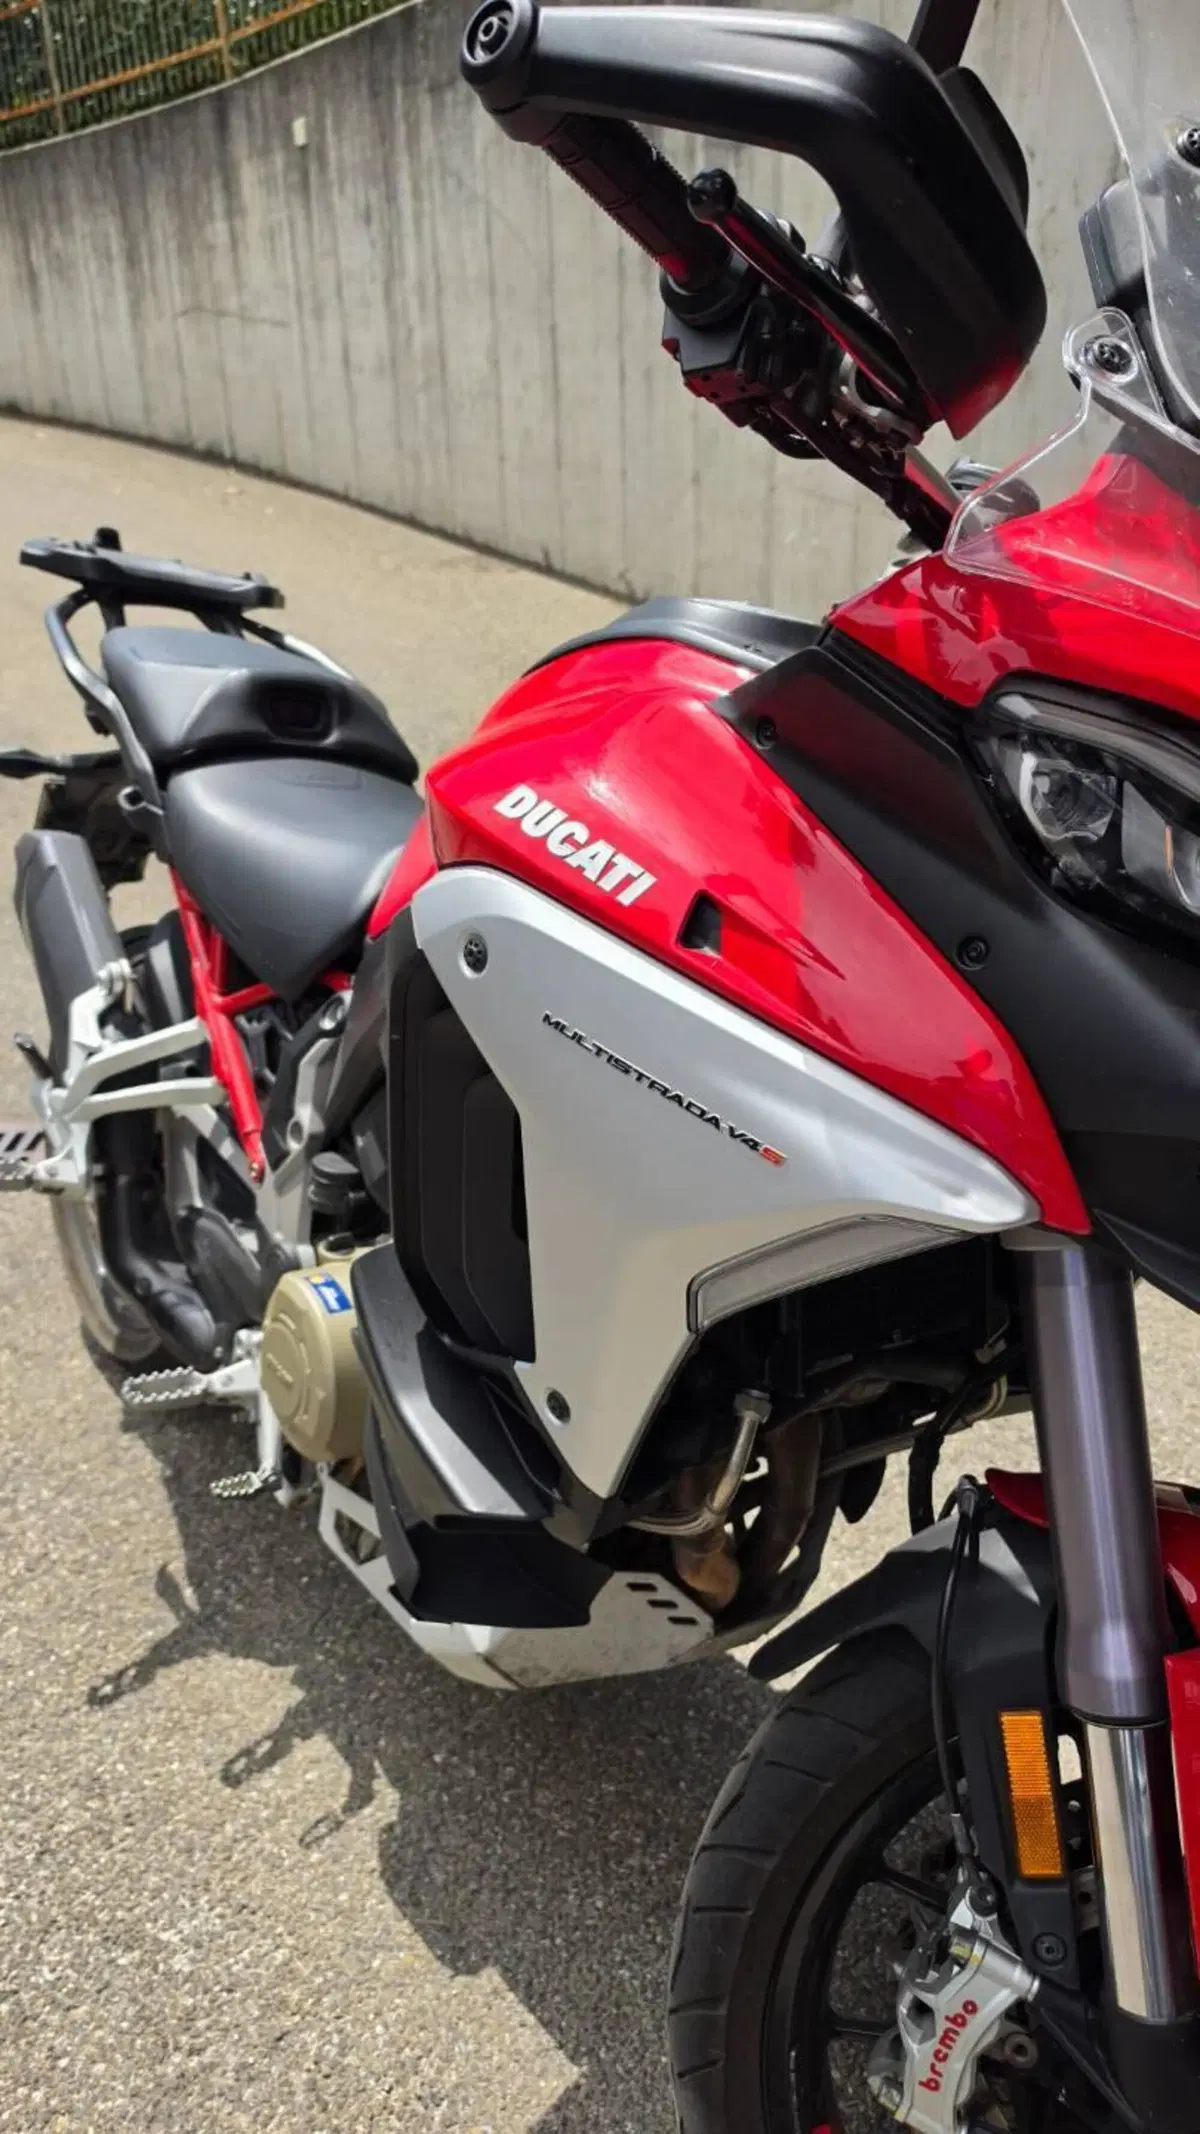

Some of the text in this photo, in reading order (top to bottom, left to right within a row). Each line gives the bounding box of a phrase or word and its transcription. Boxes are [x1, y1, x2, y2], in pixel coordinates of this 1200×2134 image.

[493, 784, 659, 907] DUCATI
[542, 1010, 722, 1132] MULTISTRADA
[918, 1999, 979, 2093] brembo
